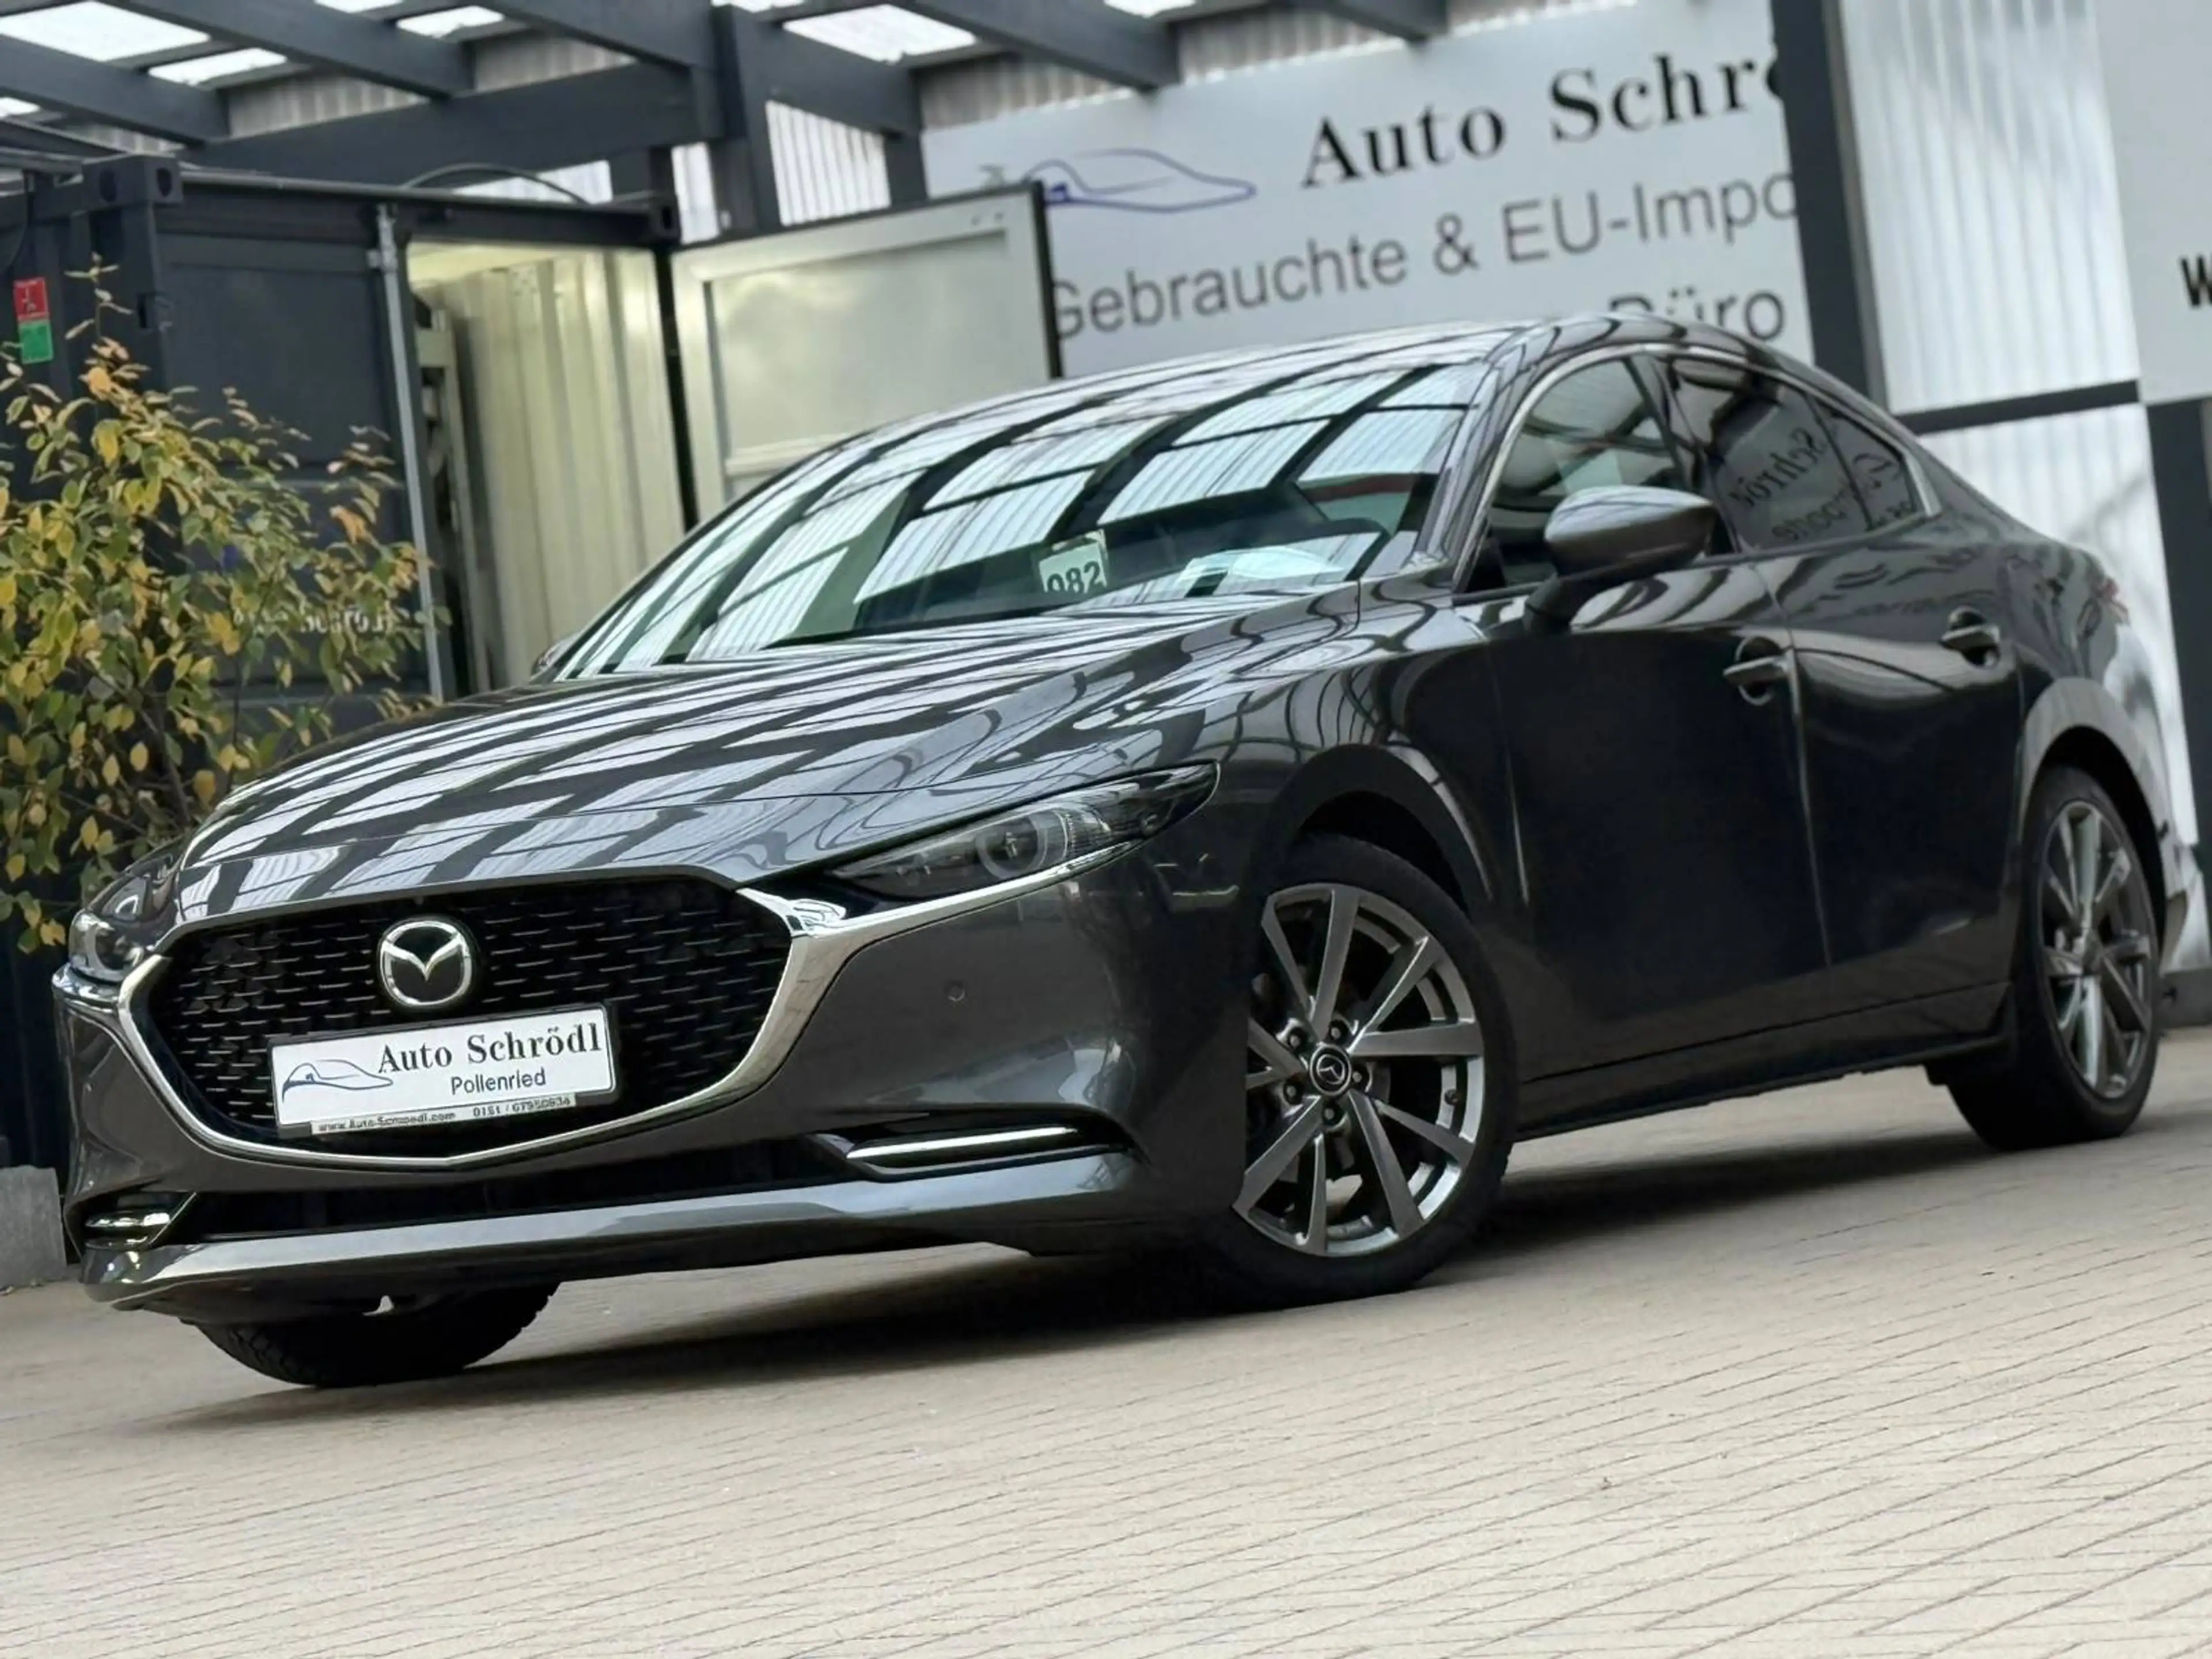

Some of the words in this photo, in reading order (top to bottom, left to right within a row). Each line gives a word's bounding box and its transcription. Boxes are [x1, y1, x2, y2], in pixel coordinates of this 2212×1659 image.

[1302, 104, 1505, 188] Auto
[1434, 213, 1479, 275] &
[1047, 560, 1104, 593] 082
[378, 1043, 452, 1073] Auto
[467, 1022, 601, 1065] Schrödl
[451, 1066, 546, 1095] Pollenried
